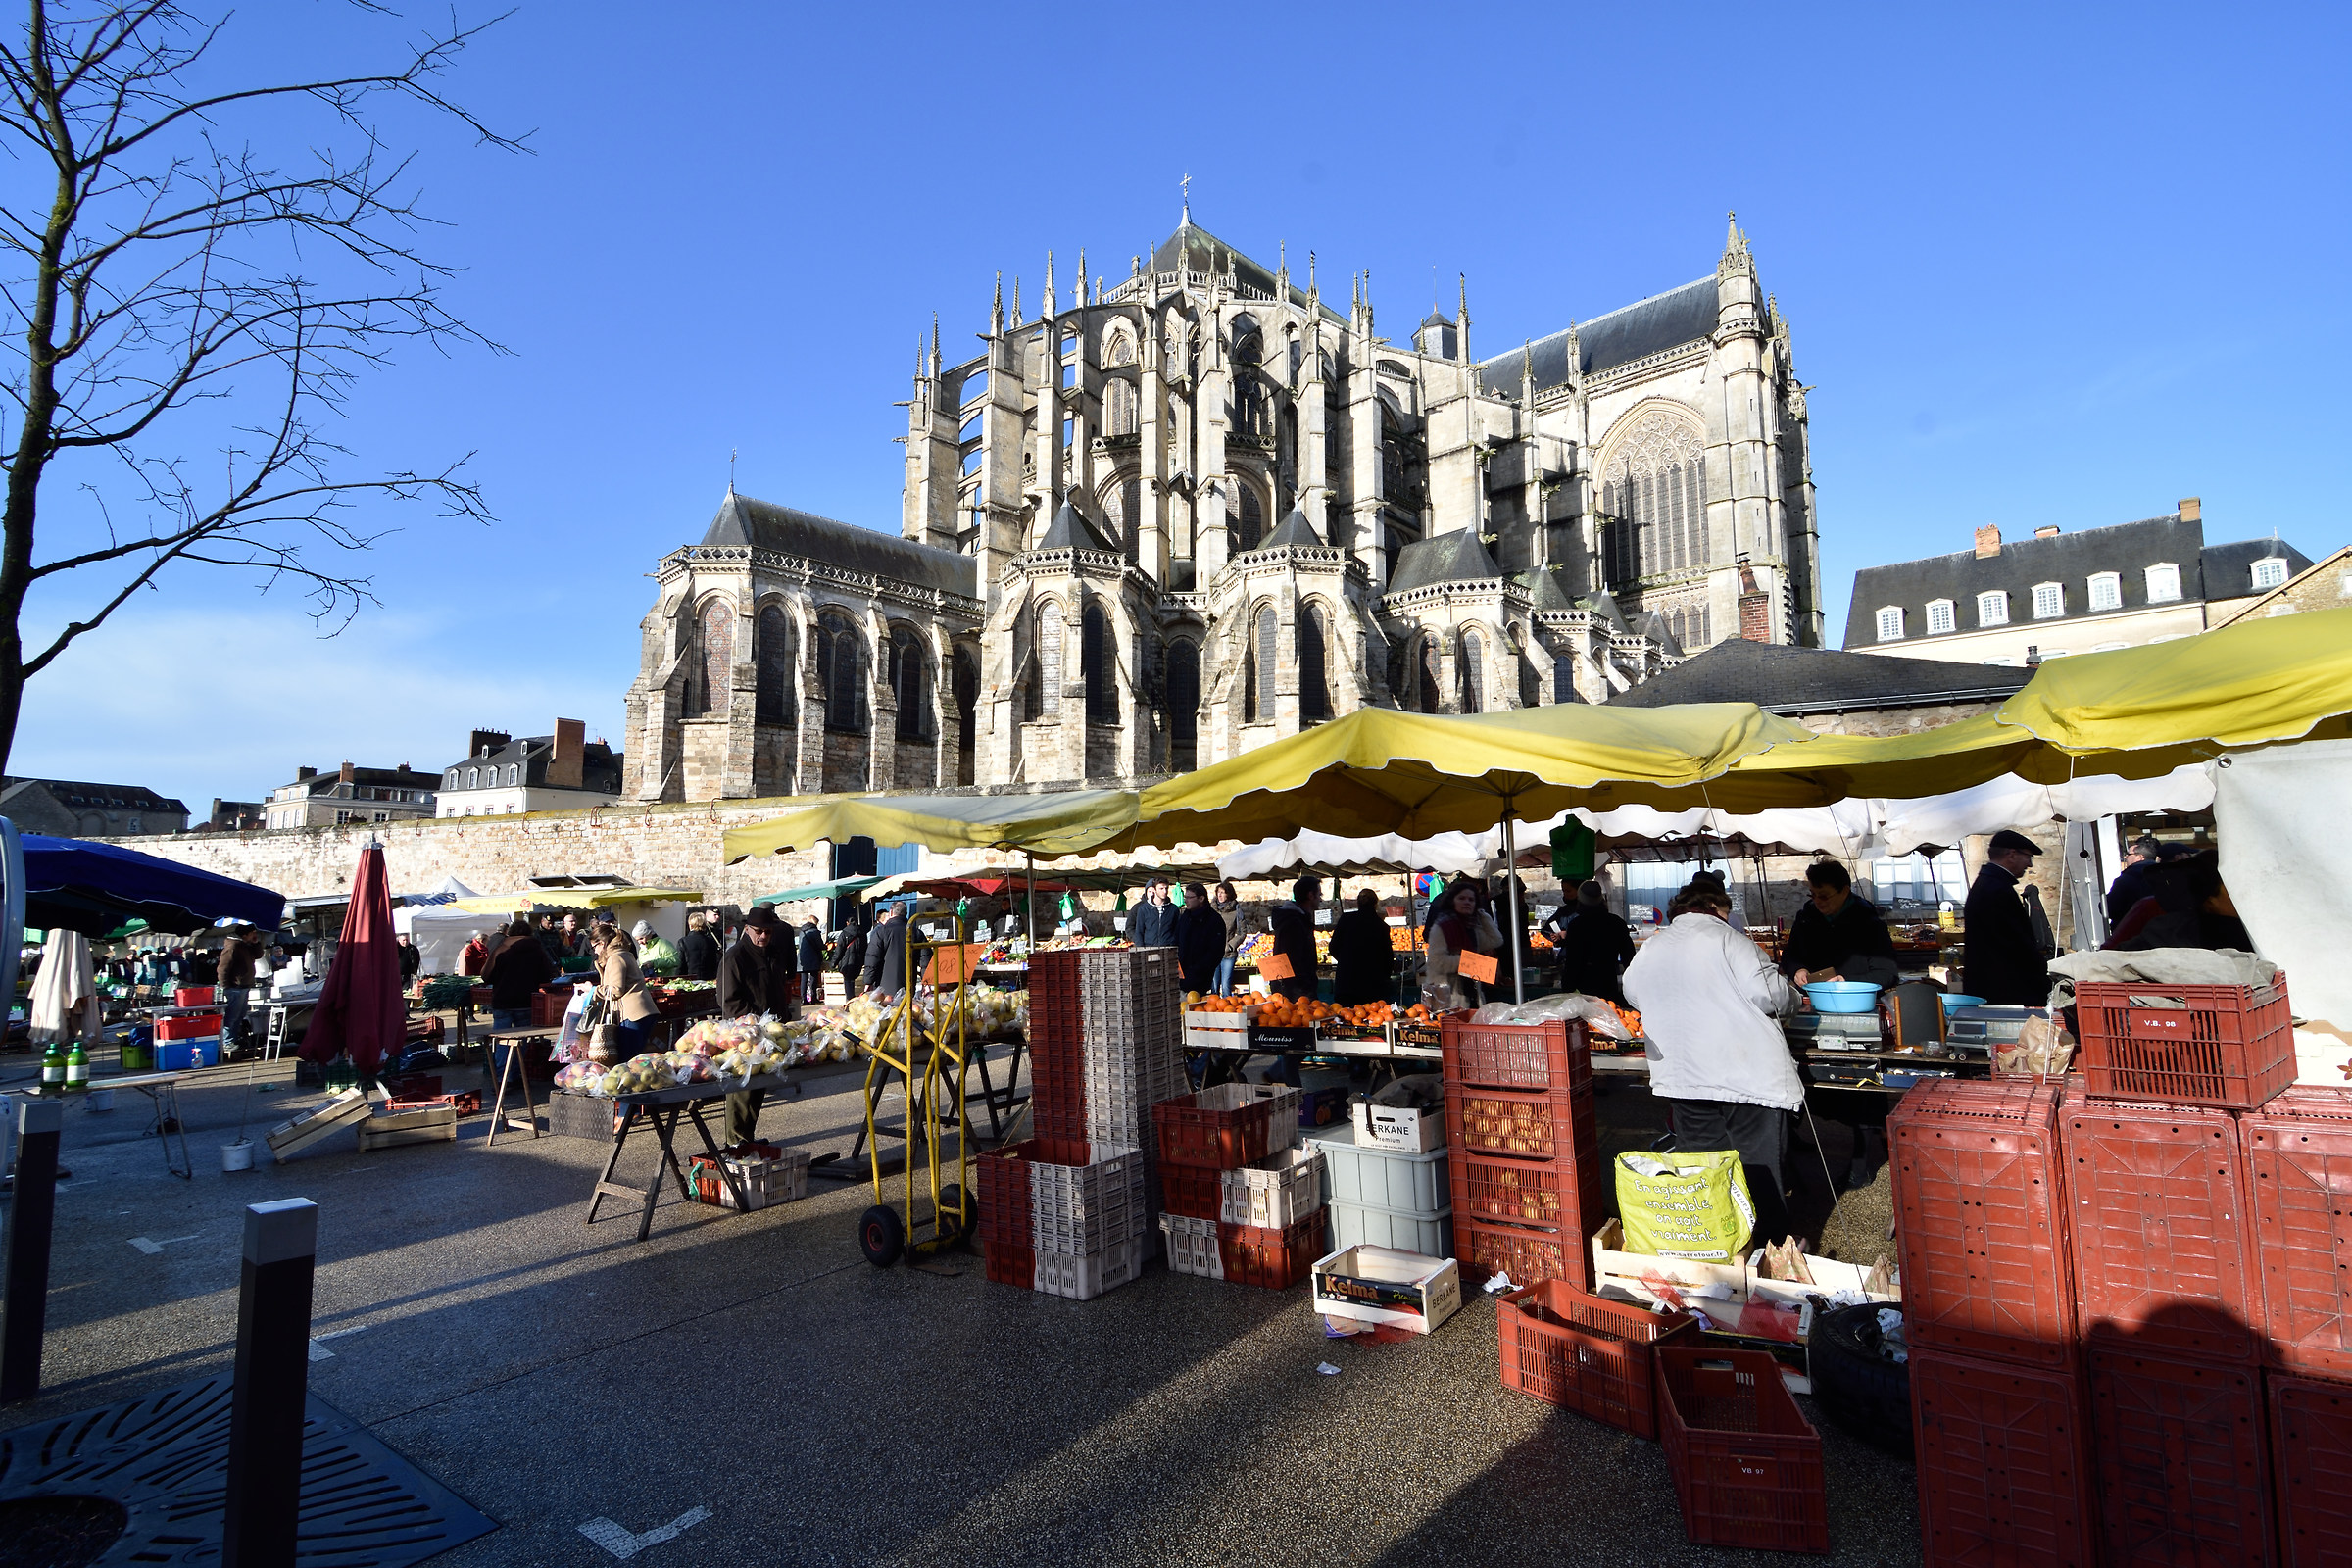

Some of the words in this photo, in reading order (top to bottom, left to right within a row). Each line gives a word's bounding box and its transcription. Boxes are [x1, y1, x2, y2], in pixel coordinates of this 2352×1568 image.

[1399, 1029, 1439, 1044] Kelma
[1590, 1039, 1617, 1051] lma
[1366, 1124, 1409, 1135] BERKANE
[1634, 1179, 1651, 1193] En
[1653, 1176, 1709, 1200] agissant
[1655, 1213, 1672, 1224] on
[1674, 1214, 1703, 1232] agit
[1650, 1228, 1717, 1243] vraiment.
[1325, 1275, 1379, 1300] Kelma
[1432, 1283, 1456, 1309] BERKANE
